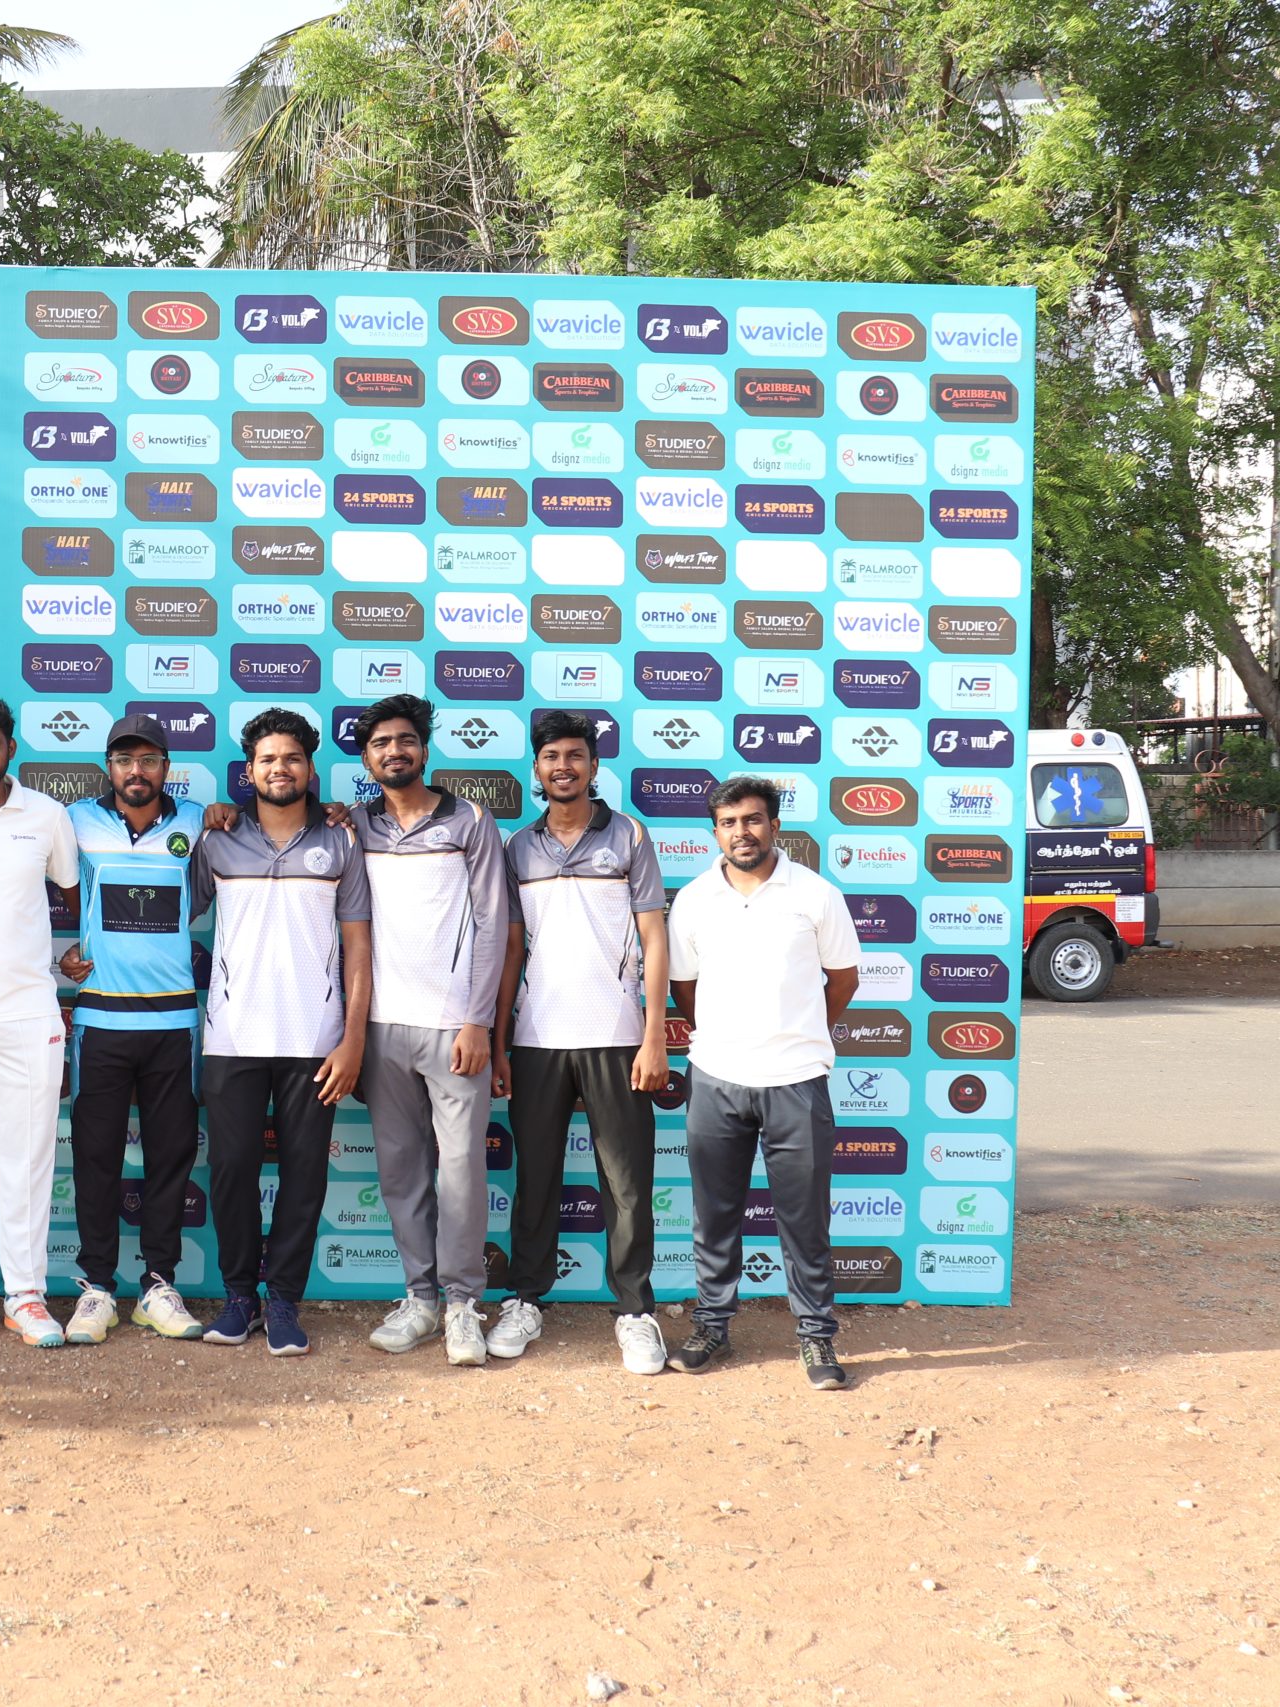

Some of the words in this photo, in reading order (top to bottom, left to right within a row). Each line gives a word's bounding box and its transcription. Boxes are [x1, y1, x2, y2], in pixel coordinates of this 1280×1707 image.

[157, 308, 193, 325] SVS
[339, 311, 424, 331] wavicle
[467, 312, 503, 330] SVS
[537, 315, 621, 333] wavicle
[740, 322, 823, 341] wavicle
[865, 325, 901, 344] SVS
[935, 327, 1017, 347] wavicle
[345, 372, 412, 385] CARIBBEAN
[543, 376, 610, 389] CARIBBEAN
[357, 385, 373, 393] Sports
[745, 382, 811, 396] CARIBBEAN
[941, 387, 1006, 402] CARIBBEAN
[149, 435, 207, 448] knowtifics
[460, 437, 517, 449] knowtifics
[351, 449, 379, 464] dsignz
[383, 451, 410, 462] media
[552, 452, 579, 466] dsignz
[583, 453, 610, 464] media
[858, 453, 914, 465] knowtifics
[753, 457, 781, 472] dsignz
[784, 459, 811, 471] media
[951, 464, 978, 478] dsignz
[981, 466, 1008, 477] media
[31, 485, 75, 497] ORTHO
[82, 487, 108, 497] ONE
[160, 482, 193, 493] HALT
[236, 479, 321, 498] wavicle
[474, 487, 508, 499] HALT
[344, 492, 359, 502] 24
[363, 493, 414, 504] SPORTS
[542, 496, 557, 506] 24
[561, 496, 611, 507] SPORTS
[640, 488, 723, 508] wavicle
[745, 502, 760, 512] 24
[764, 503, 814, 513] SPORTS
[939, 508, 954, 518] 24
[958, 508, 1007, 519] SPORTS
[56, 536, 90, 548] HALT
[148, 545, 209, 555] PALMROOT
[457, 551, 517, 560] PALMROOT
[860, 565, 918, 574] PALMROOT
[26, 596, 112, 616] wavicle
[238, 604, 282, 615] ORTHO
[289, 604, 315, 615] ONE
[438, 604, 523, 623] wavicle
[642, 612, 685, 623] ORTHO
[692, 612, 717, 623] ONE
[838, 613, 920, 632] wavicle
[852, 737, 899, 745] NIVIA
[43, 780, 88, 794] PRIME
[455, 786, 503, 798] PRIME
[962, 785, 992, 794] HALT
[857, 791, 890, 809] SVS
[950, 796, 992, 809] SPORTS
[657, 840, 708, 854] Techies
[1037, 845, 1100, 858] ஆர்த்தோ
[1113, 843, 1138, 857] ஒன்
[674, 854, 694, 862] Sports
[857, 848, 906, 861] Techies
[936, 848, 1001, 861] CARIBBEAN
[930, 913, 971, 923] ORTHO
[979, 913, 1003, 923] ONE
[956, 1028, 989, 1045] SVS
[847, 1143, 896, 1152] SPORTS
[946, 1149, 1002, 1161] knowtifics
[338, 1210, 366, 1224] dsignz
[370, 1213, 392, 1222] medi
[663, 1216, 690, 1226] media
[937, 1220, 964, 1234] dsignz
[968, 1221, 994, 1232] media
[346, 1250, 398, 1258] PALMROO
[939, 1255, 997, 1264] PALMROOT
